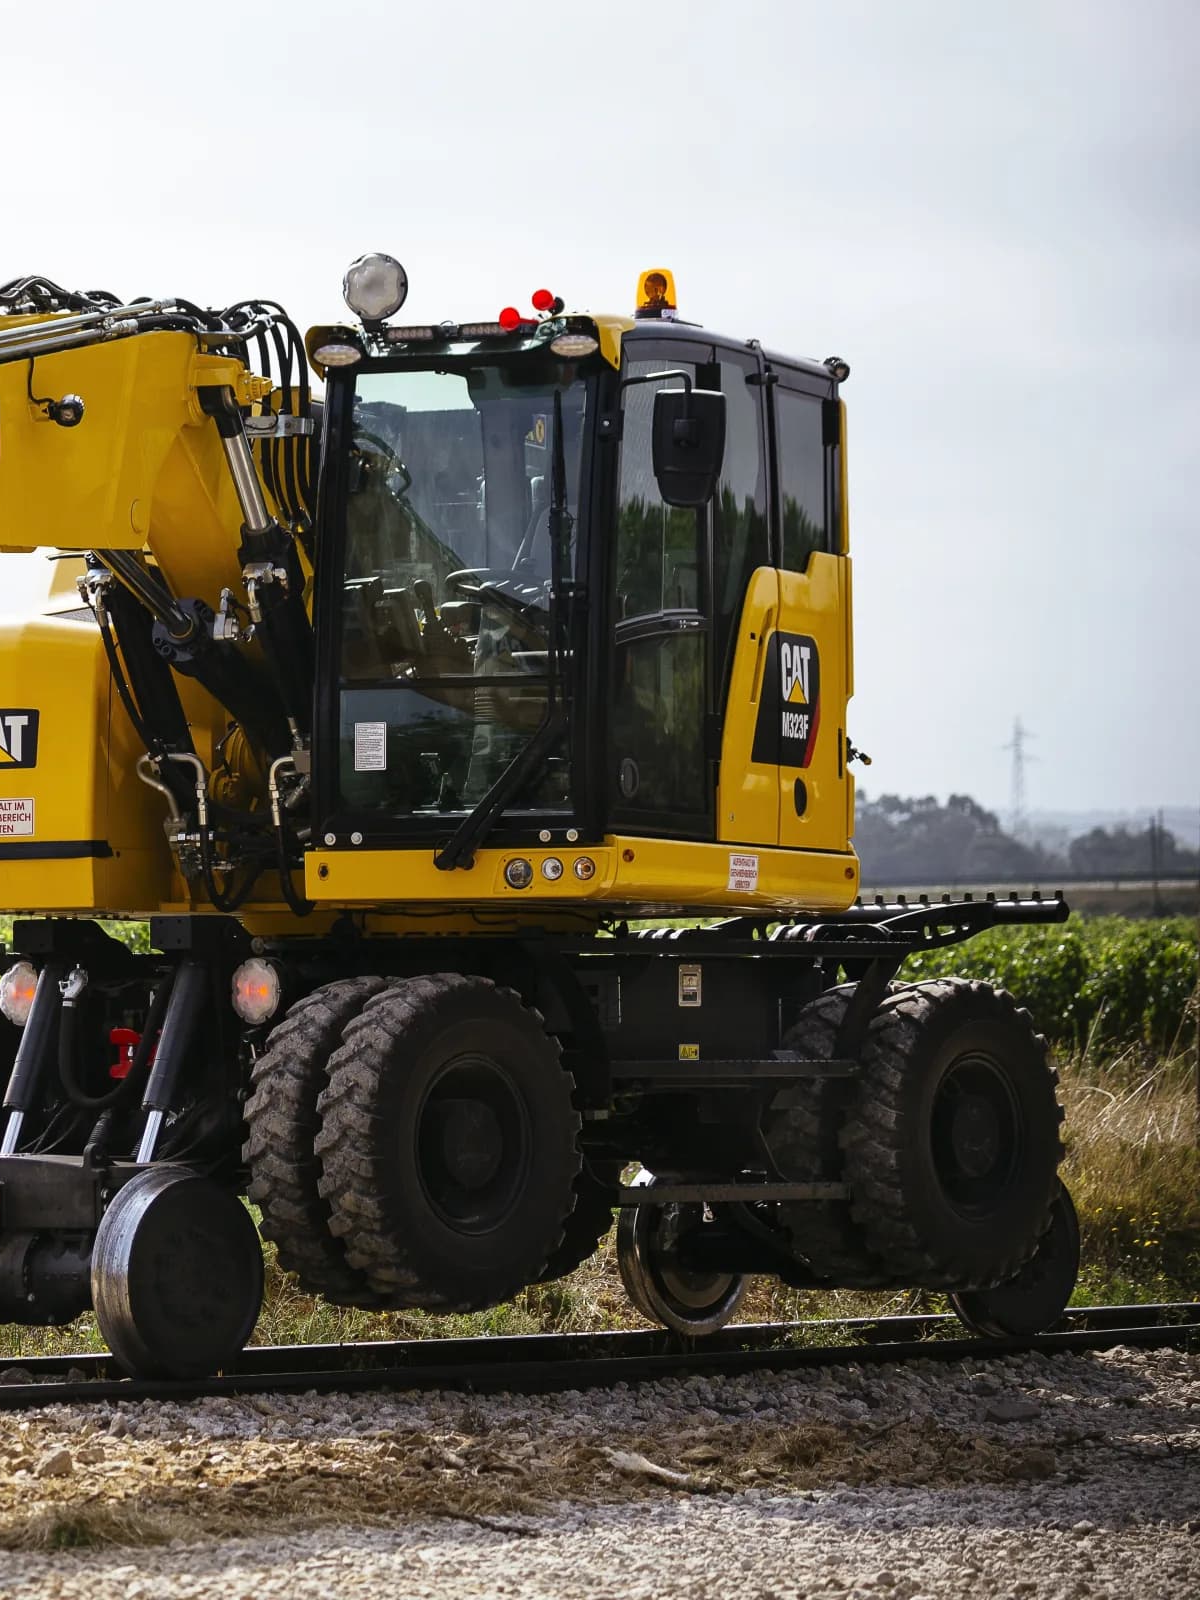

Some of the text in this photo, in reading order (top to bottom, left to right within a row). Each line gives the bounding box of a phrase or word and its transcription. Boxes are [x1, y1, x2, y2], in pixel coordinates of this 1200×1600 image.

[781, 642, 810, 704] CAT
[782, 712, 809, 739] M323F
[14, 802, 25, 811] IM
